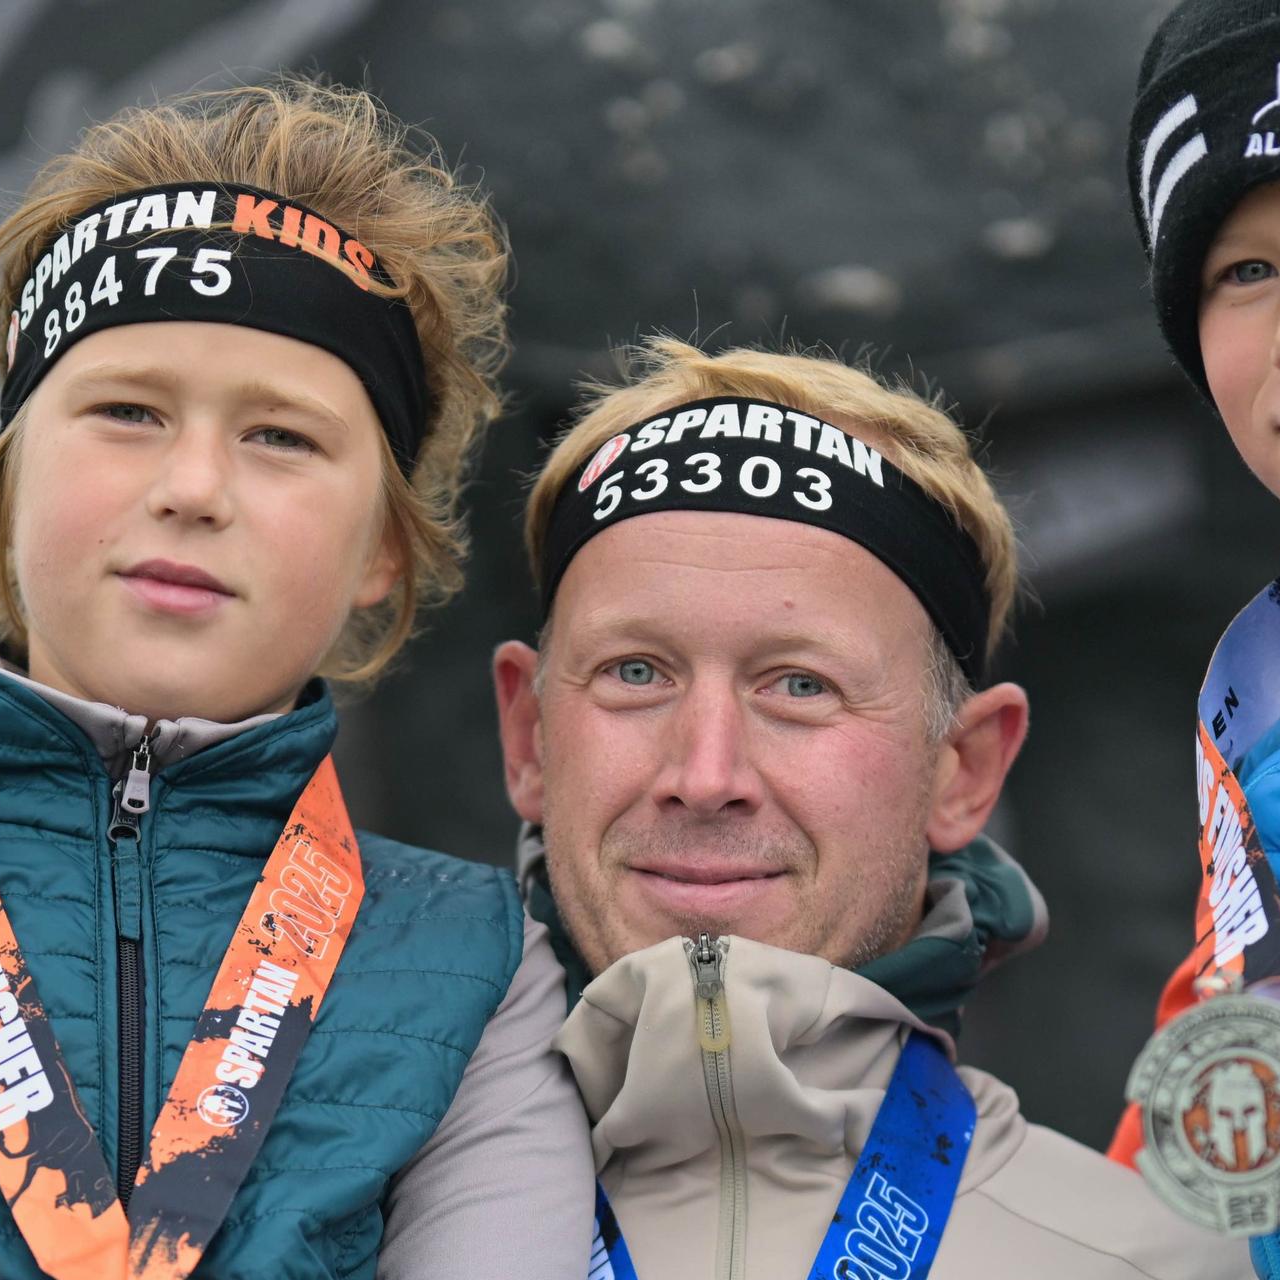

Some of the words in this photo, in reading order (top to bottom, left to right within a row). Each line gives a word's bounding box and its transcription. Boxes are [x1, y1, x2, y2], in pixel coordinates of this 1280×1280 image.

[21, 190, 217, 330] SPARTAN
[232, 193, 374, 291] KIDS
[43, 247, 232, 358] 88475
[593, 452, 833, 521] 53303
[631, 403, 885, 488] SPARTAN
[215, 959, 300, 1088] SPARTAN
[259, 838, 353, 961] 2025
